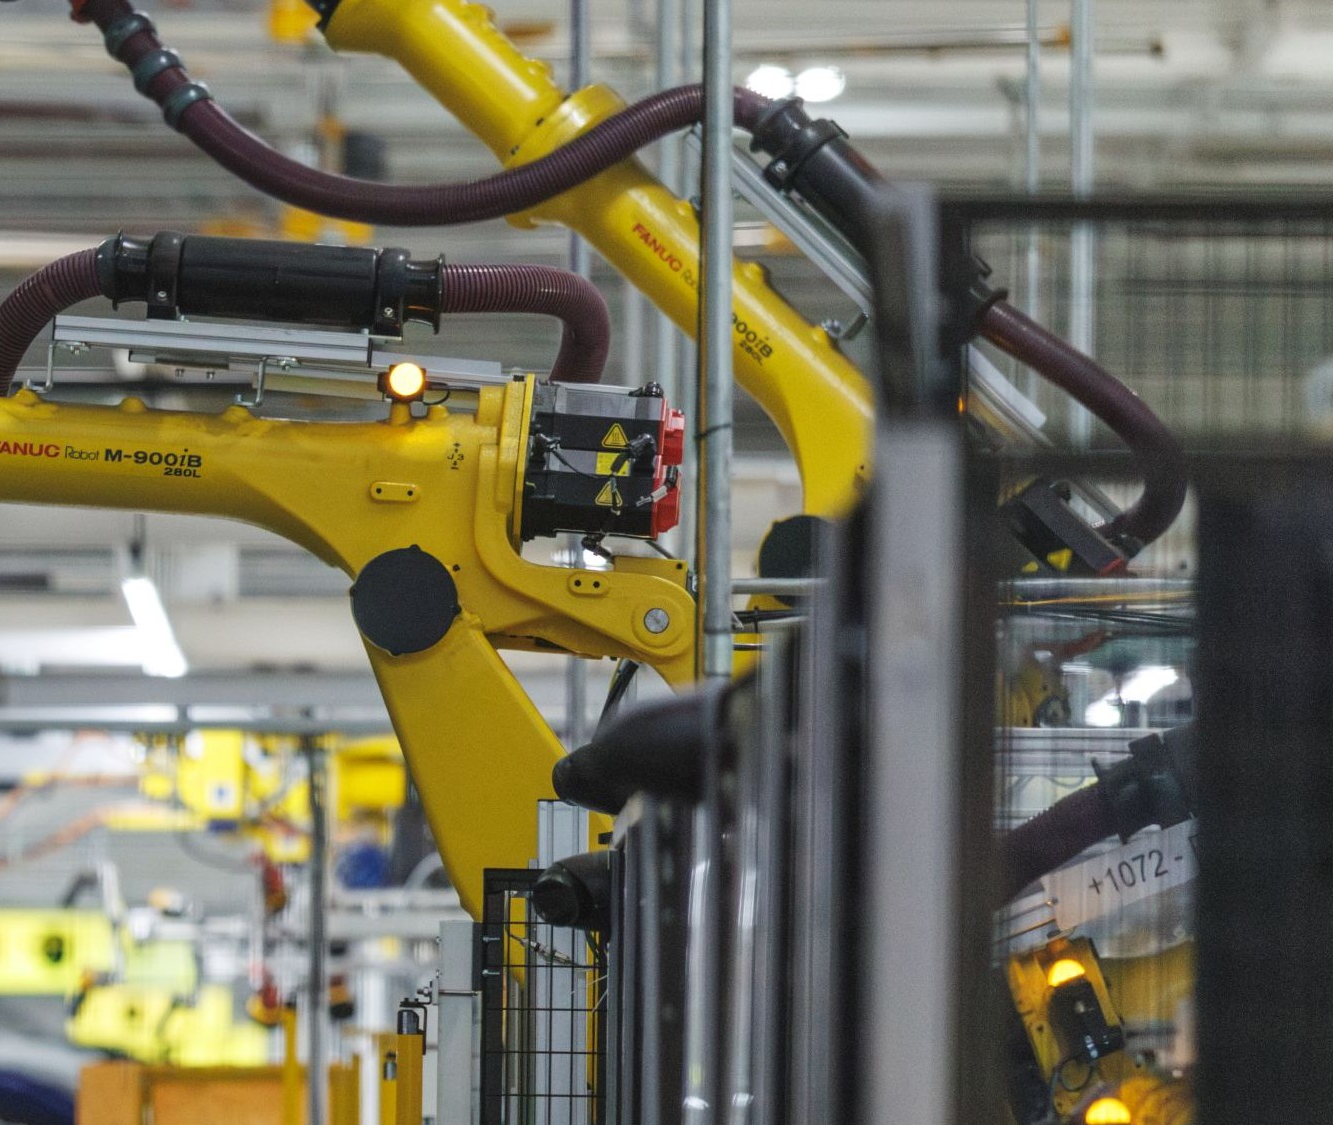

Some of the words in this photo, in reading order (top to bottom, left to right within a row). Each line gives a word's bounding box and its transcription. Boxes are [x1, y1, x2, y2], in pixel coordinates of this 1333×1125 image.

[632, 223, 683, 273] FANUC
[732, 311, 774, 359] 00iB
[64, 445, 100, 461] Robot
[104, 448, 203, 469] M-900iB
[163, 467, 202, 479] 280L
